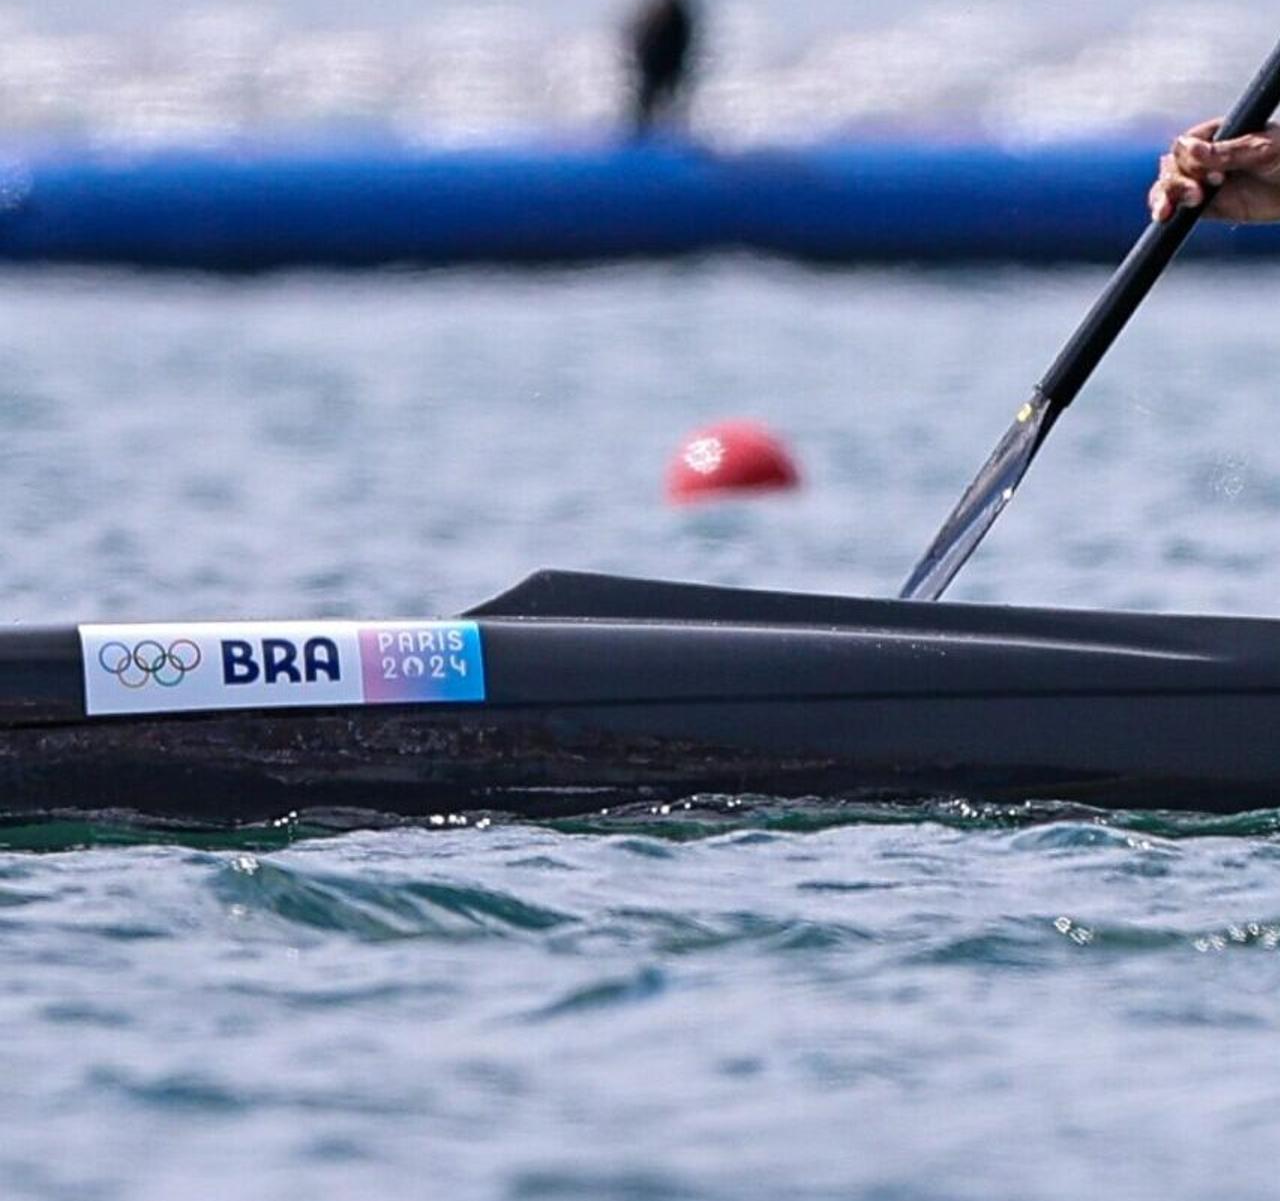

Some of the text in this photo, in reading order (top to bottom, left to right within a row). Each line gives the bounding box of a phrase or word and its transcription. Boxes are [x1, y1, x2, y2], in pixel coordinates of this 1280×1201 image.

[377, 630, 464, 653] PARIS
[221, 636, 341, 685] BRA
[382, 655, 467, 679] 2024
